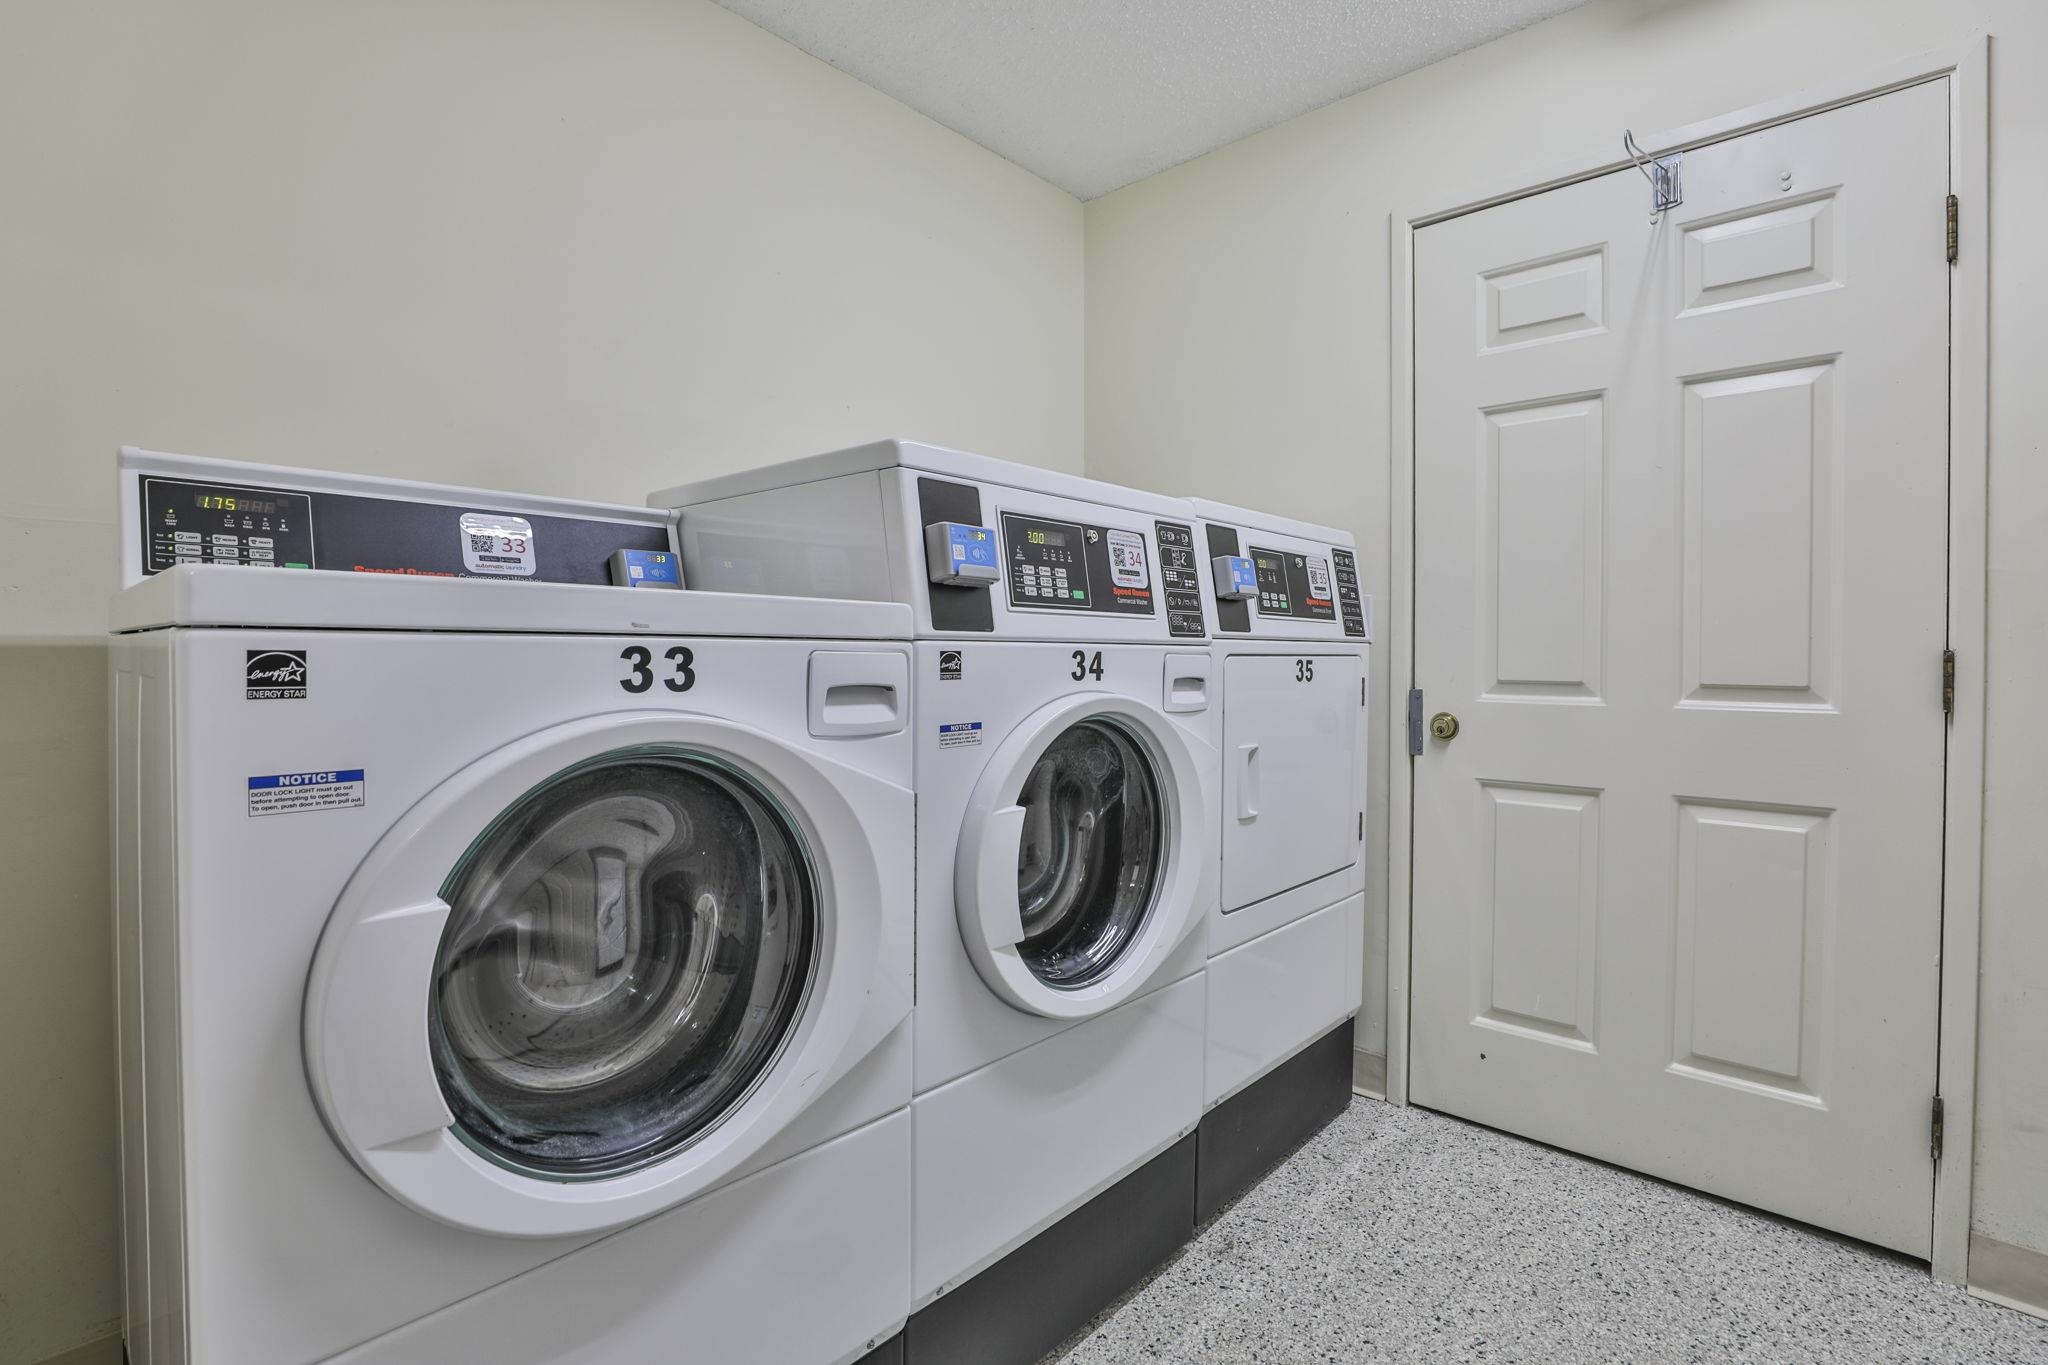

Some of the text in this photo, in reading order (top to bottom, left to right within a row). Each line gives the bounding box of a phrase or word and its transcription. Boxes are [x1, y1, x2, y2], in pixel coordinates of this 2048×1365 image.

[977, 531, 986, 540] 34
[501, 537, 526, 554] 33
[1128, 550, 1142, 567] 34
[620, 645, 695, 693] 33
[1071, 650, 1104, 681] 34
[1296, 659, 1313, 682] 35
[247, 689, 306, 699] ENERGY STAR
[950, 723, 972, 732] NOTICE
[279, 772, 337, 786] NOTICE
[273, 795, 309, 803] attempting
